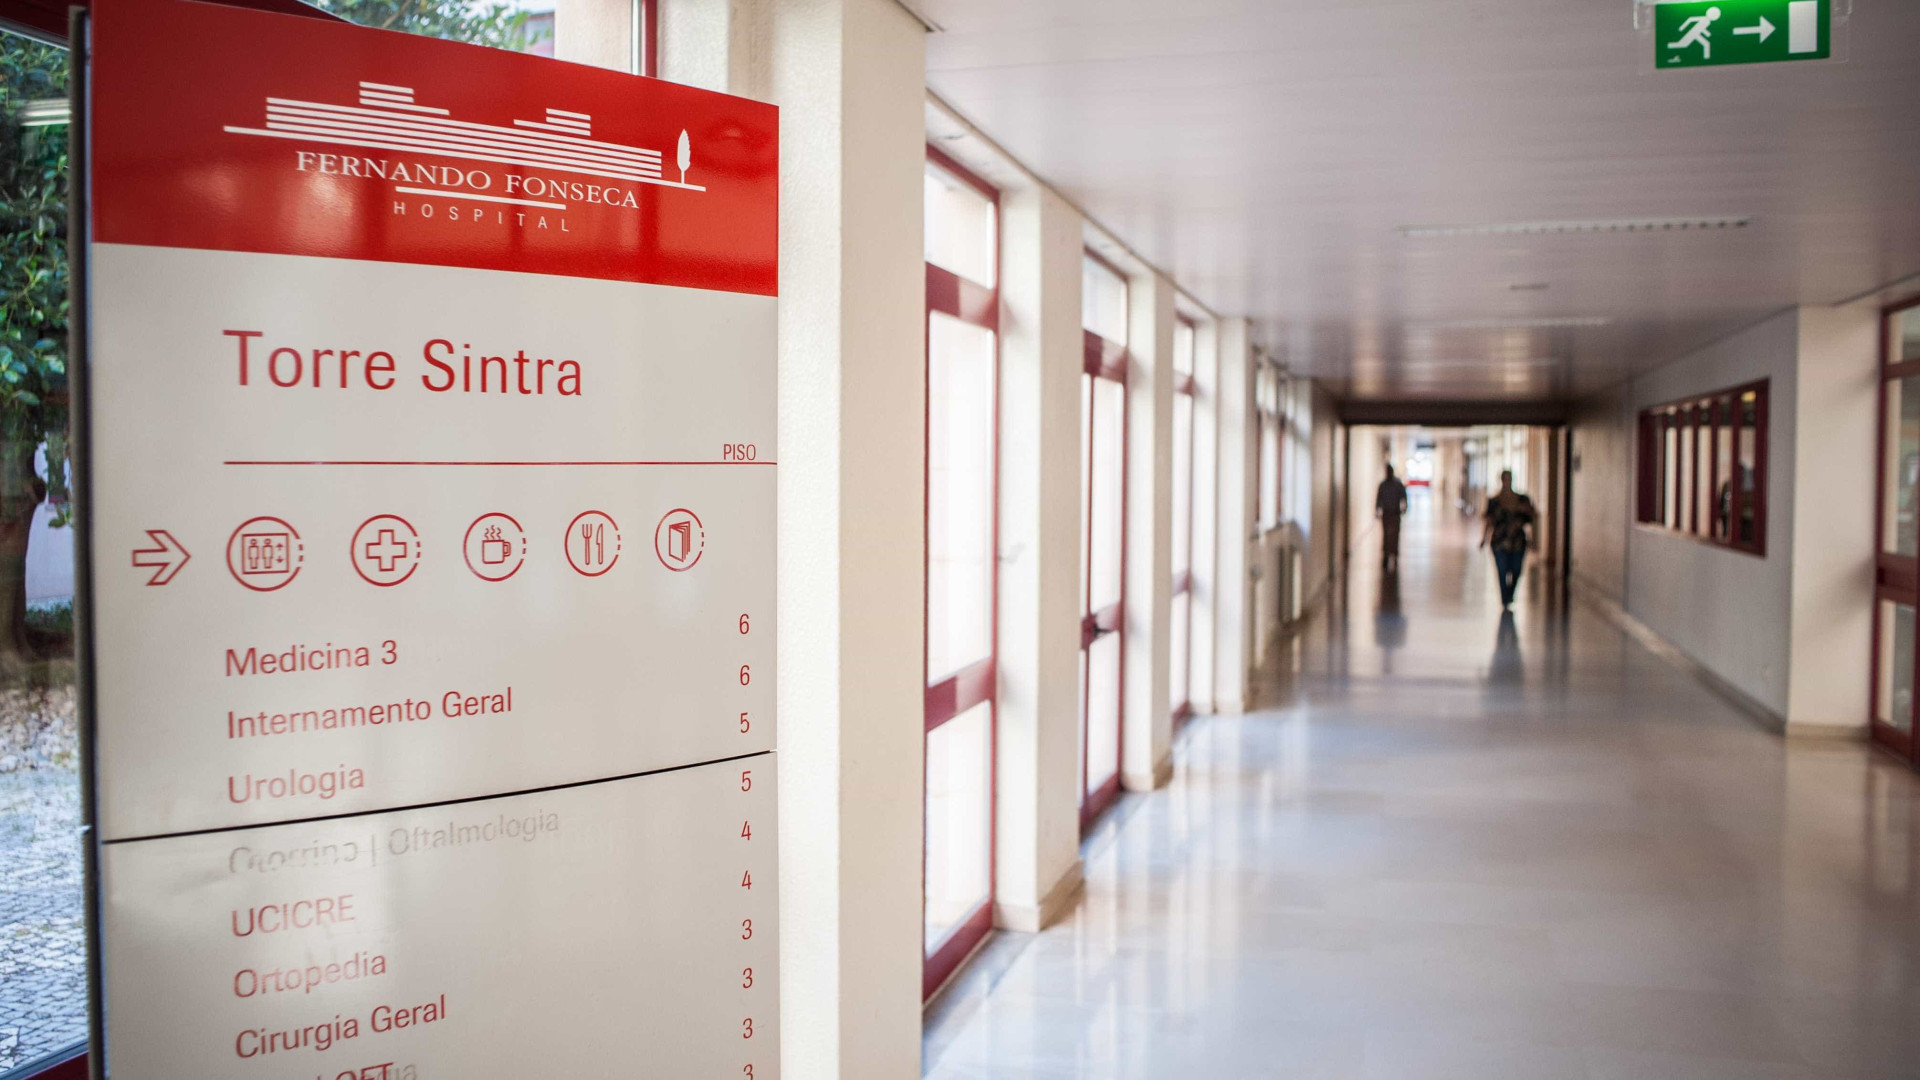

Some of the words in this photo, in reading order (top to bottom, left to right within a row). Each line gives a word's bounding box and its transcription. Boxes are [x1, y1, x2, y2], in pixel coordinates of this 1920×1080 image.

[295, 151, 492, 190] FERNANDO
[505, 173, 640, 209] FONSECA
[394, 201, 570, 232] HOSPITAL
[222, 329, 397, 391] Torre
[421, 338, 582, 397] Sintra
[722, 443, 757, 461] PISO
[738, 612, 751, 636] 6
[226, 643, 371, 677] Medicina
[382, 640, 398, 666] 3
[739, 664, 752, 686] 6
[228, 698, 433, 740] Internamento
[441, 686, 513, 719] Geral
[740, 712, 751, 735] 5
[228, 764, 365, 805] Urologia
[741, 770, 753, 792] 5
[388, 808, 559, 857] Oftalmologia
[740, 820, 753, 842] 4
[741, 869, 753, 891] 4
[231, 894, 355, 938] UCICRE
[741, 919, 753, 940] 3
[233, 952, 388, 999] Ortopedia
[742, 967, 754, 989] 3
[235, 1014, 360, 1059] Cirurgia
[371, 994, 447, 1034] Geral
[742, 1017, 754, 1039] 3
